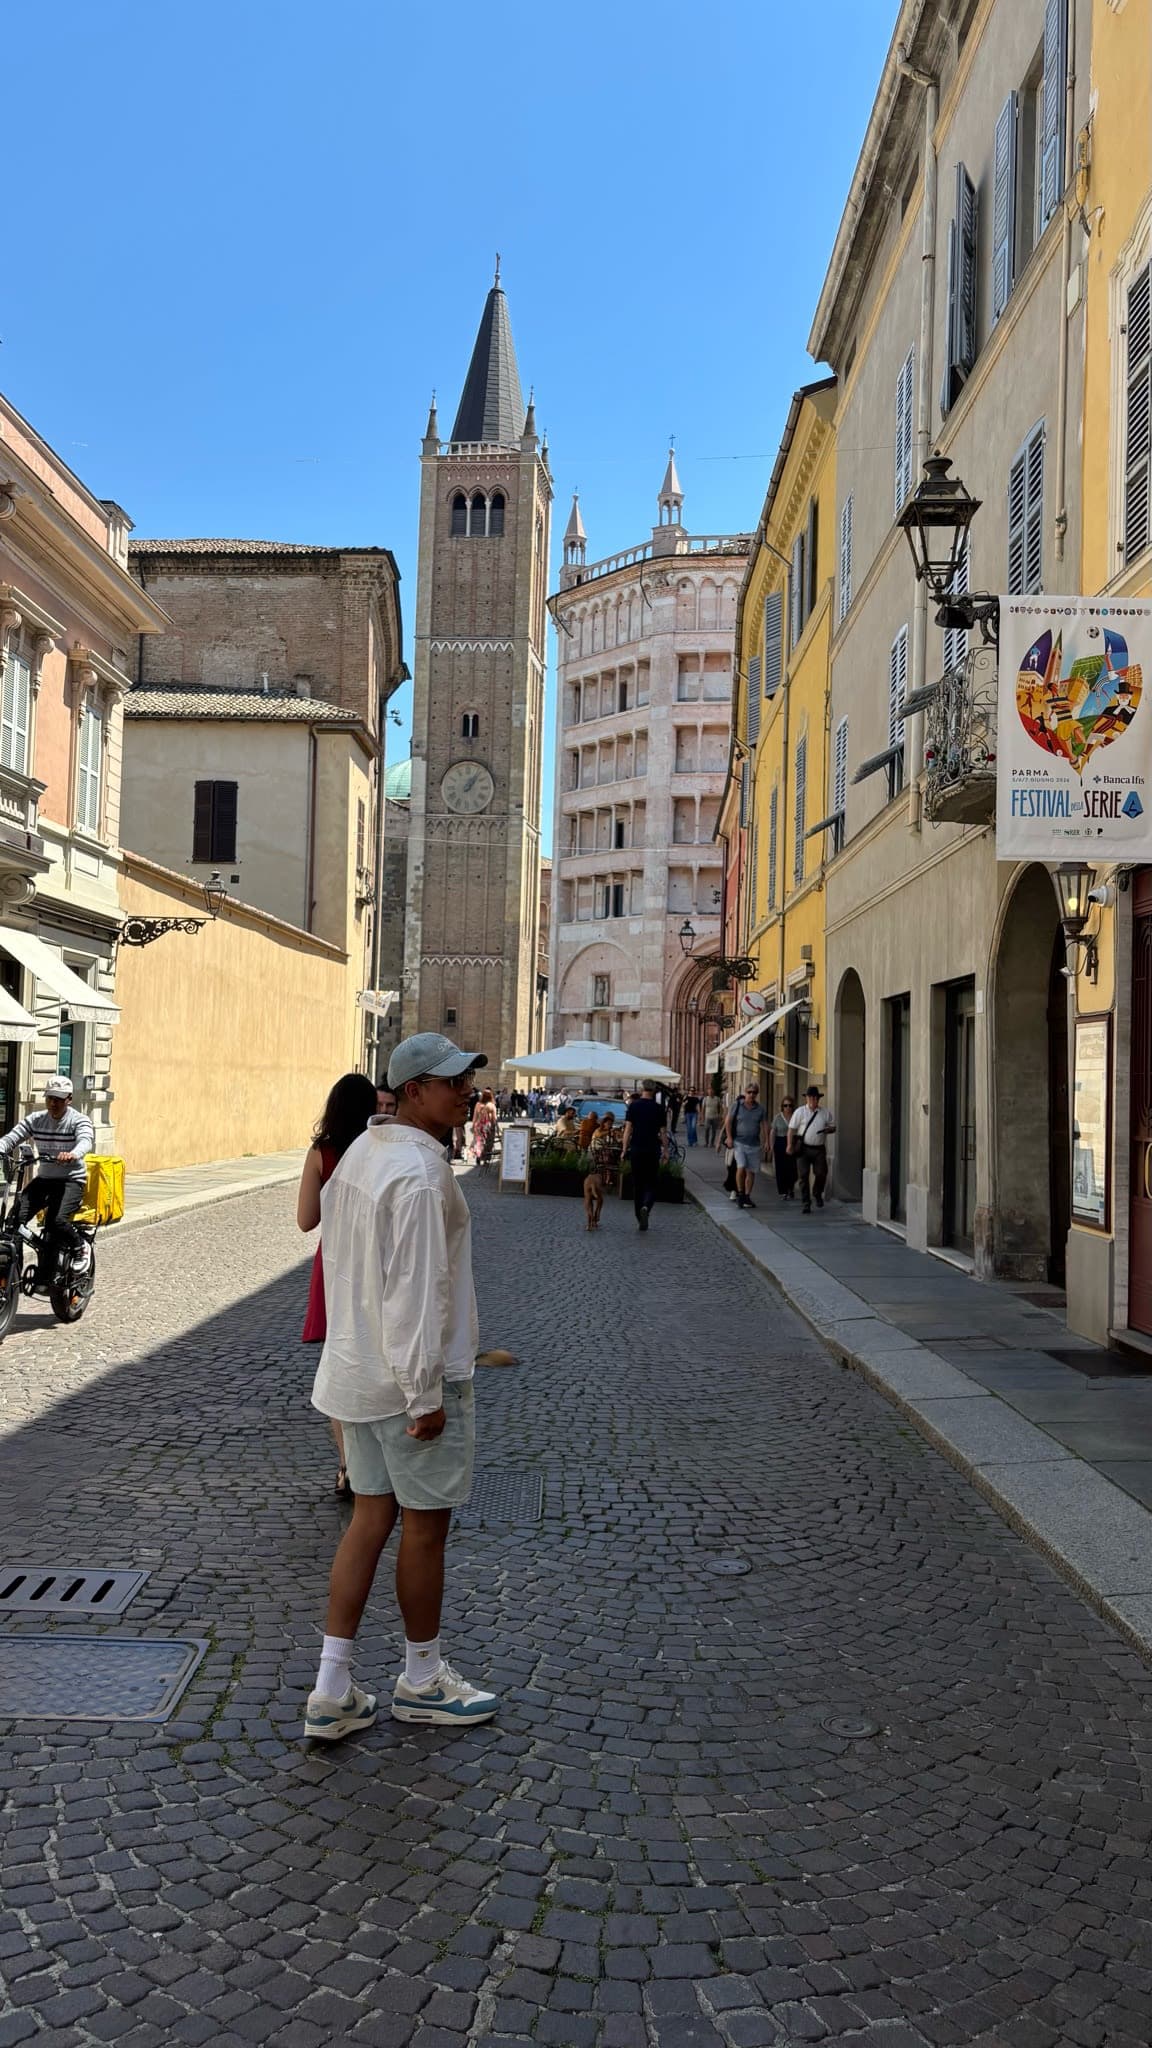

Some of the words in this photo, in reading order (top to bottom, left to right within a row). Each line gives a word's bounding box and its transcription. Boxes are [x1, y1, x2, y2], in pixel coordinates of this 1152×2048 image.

[1103, 776, 1130, 784] Banca
[1132, 776, 1145, 785] Ifis
[1011, 790, 1072, 818] FESTIVAL
[1083, 790, 1122, 818] SERIE
